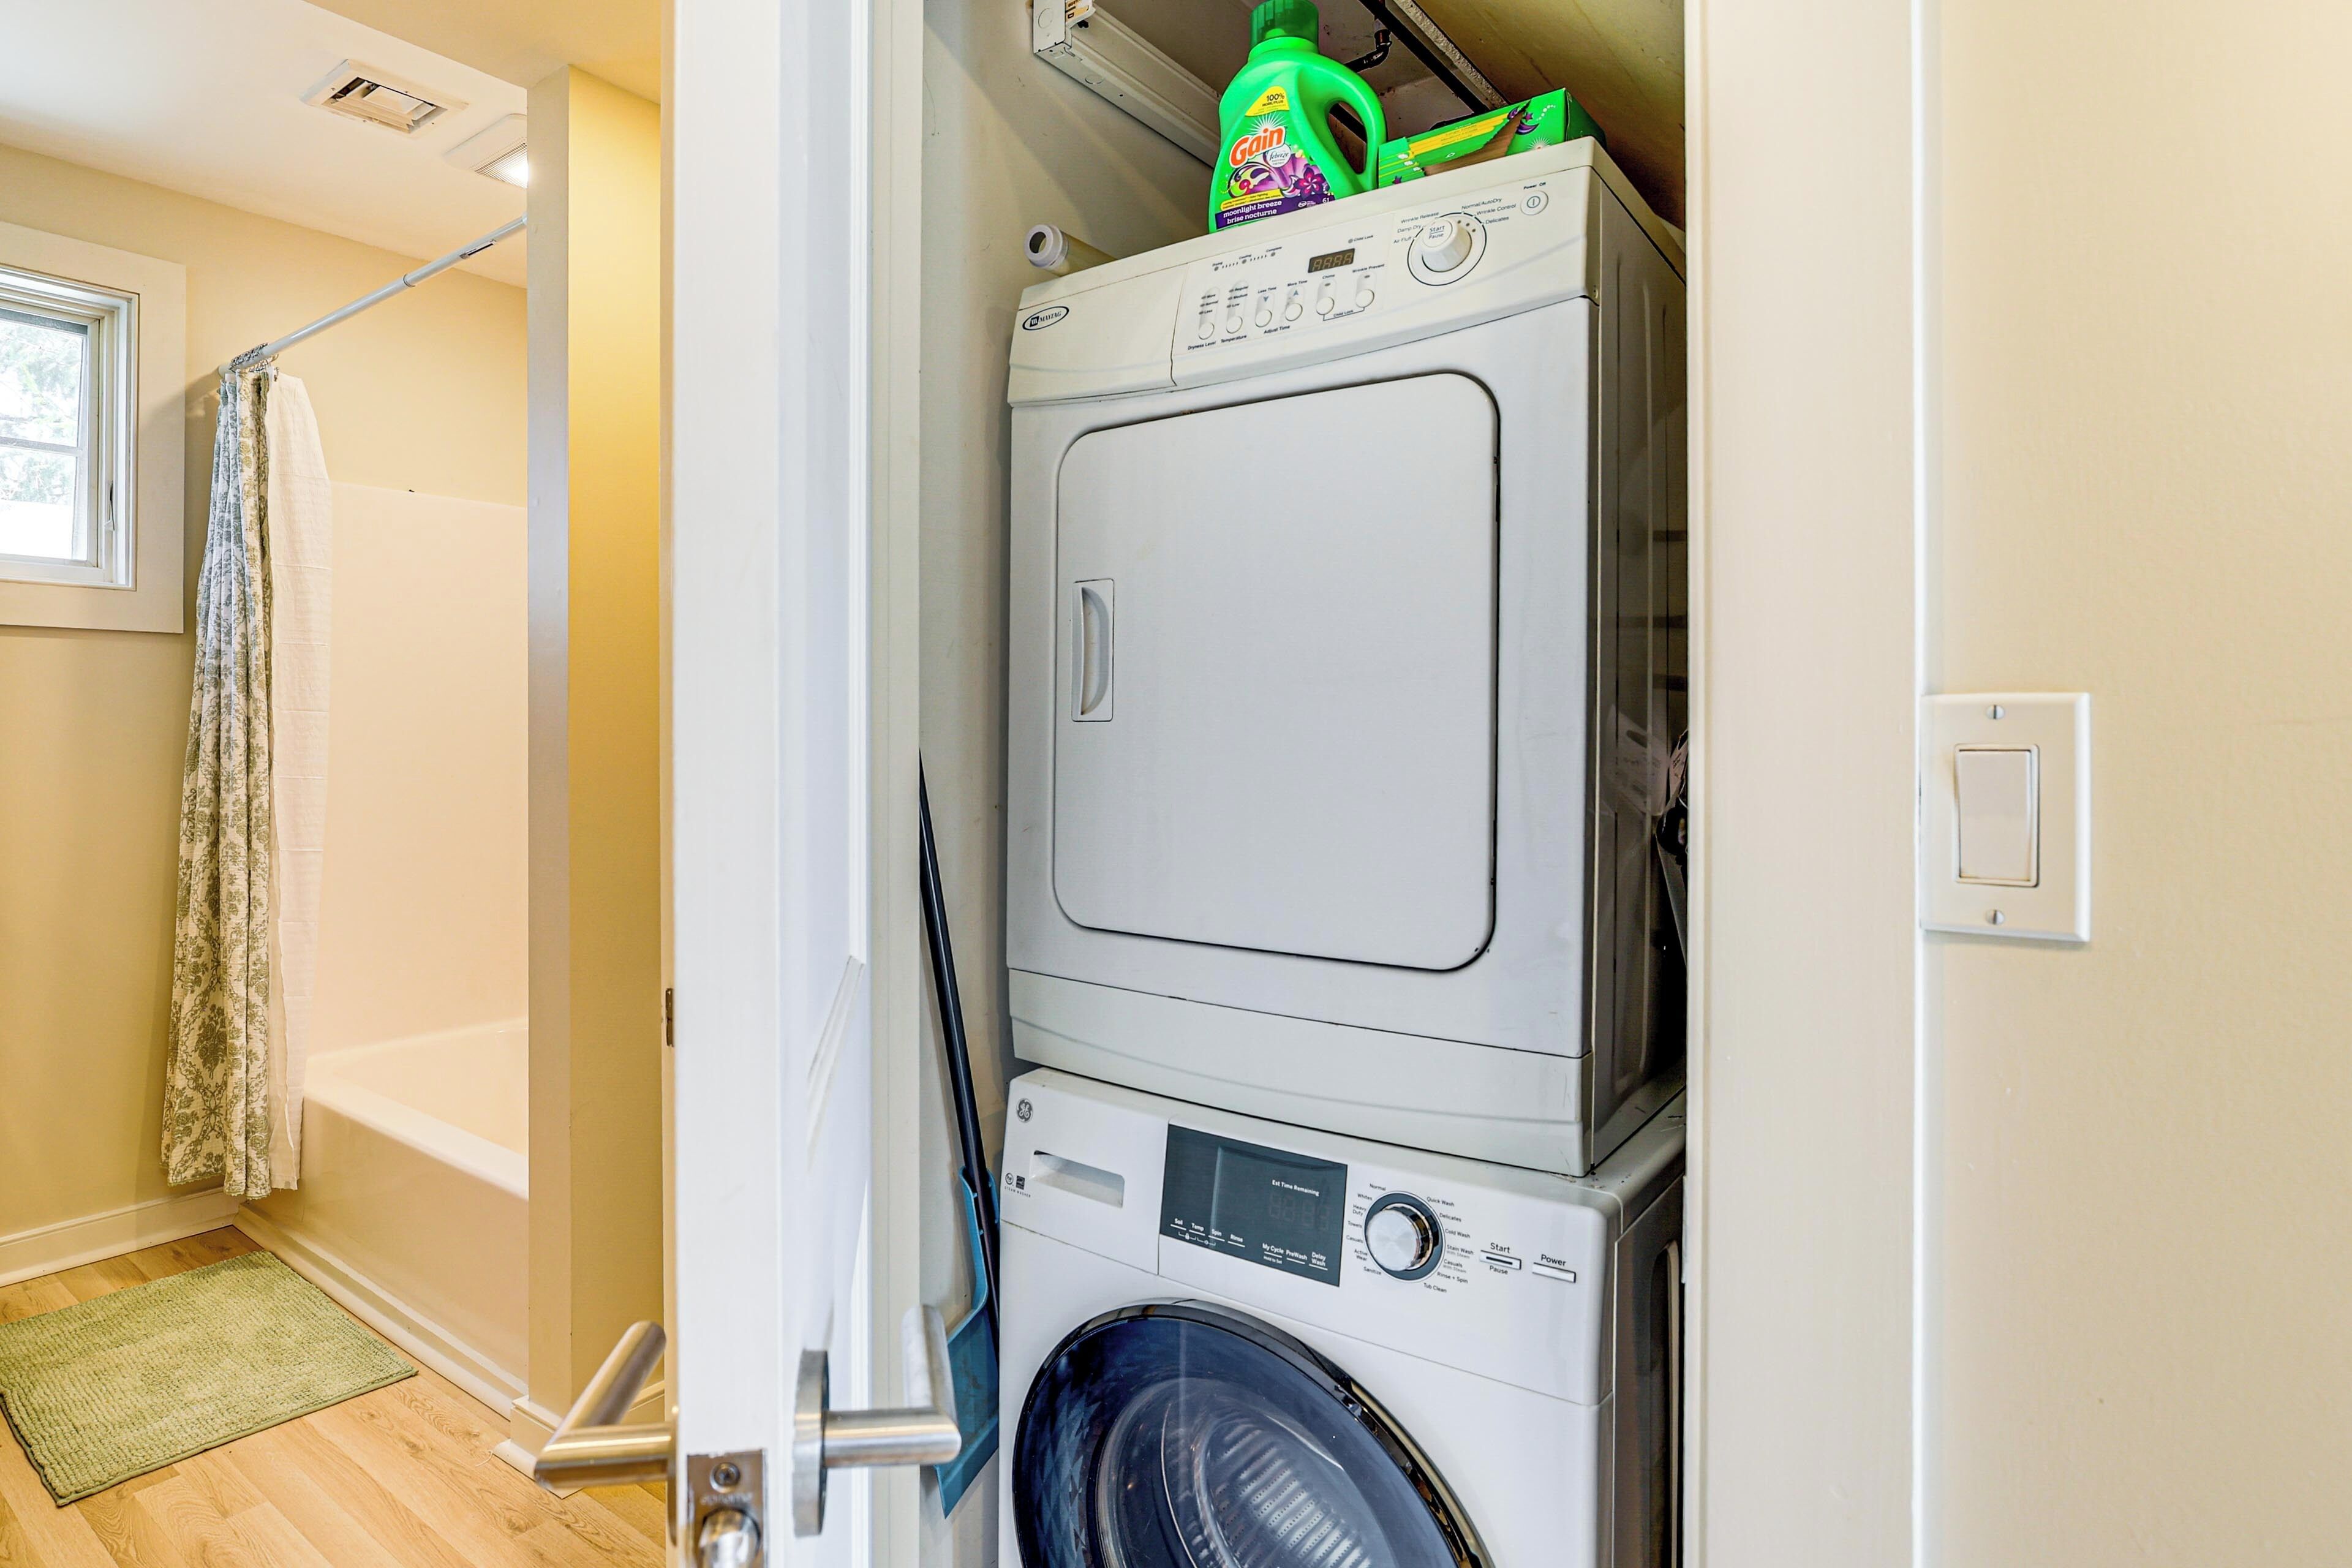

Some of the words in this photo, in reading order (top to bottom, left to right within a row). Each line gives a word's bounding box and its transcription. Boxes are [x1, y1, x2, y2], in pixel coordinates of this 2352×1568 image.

[1267, 92, 1285, 102] 100%
[1230, 127, 1284, 167] Gain
[1269, 151, 1289, 160] febreze
[1223, 205, 1256, 219] moonlight
[1257, 200, 1282, 209] breeze
[1461, 198, 1502, 211] Normal/AutoDry
[1227, 216, 1244, 225] brise
[1244, 209, 1277, 219] nocturne
[1485, 216, 1510, 225] Delicates
[1039, 311, 1061, 322] MAYTAG
[1294, 1185, 1319, 1197] Remaining
[1370, 1183, 1386, 1191] Normal
[1439, 1212, 1461, 1223] Delicates
[1191, 1223, 1204, 1232] Temp
[1230, 1234, 1243, 1243] Rinse
[1346, 1235, 1363, 1243] Casuals
[1270, 1245, 1284, 1254] Cycle
[1490, 1242, 1510, 1254] Start
[1286, 1250, 1308, 1261] PreWash
[1311, 1251, 1326, 1262] Delay
[1540, 1253, 1567, 1267] Power
[1311, 1258, 1325, 1267] Wash
[1443, 1259, 1463, 1268] Casuals
[1363, 1266, 1382, 1275] Sanitize
[1489, 1264, 1509, 1275] Pause
[1433, 1285, 1447, 1294] Clean
